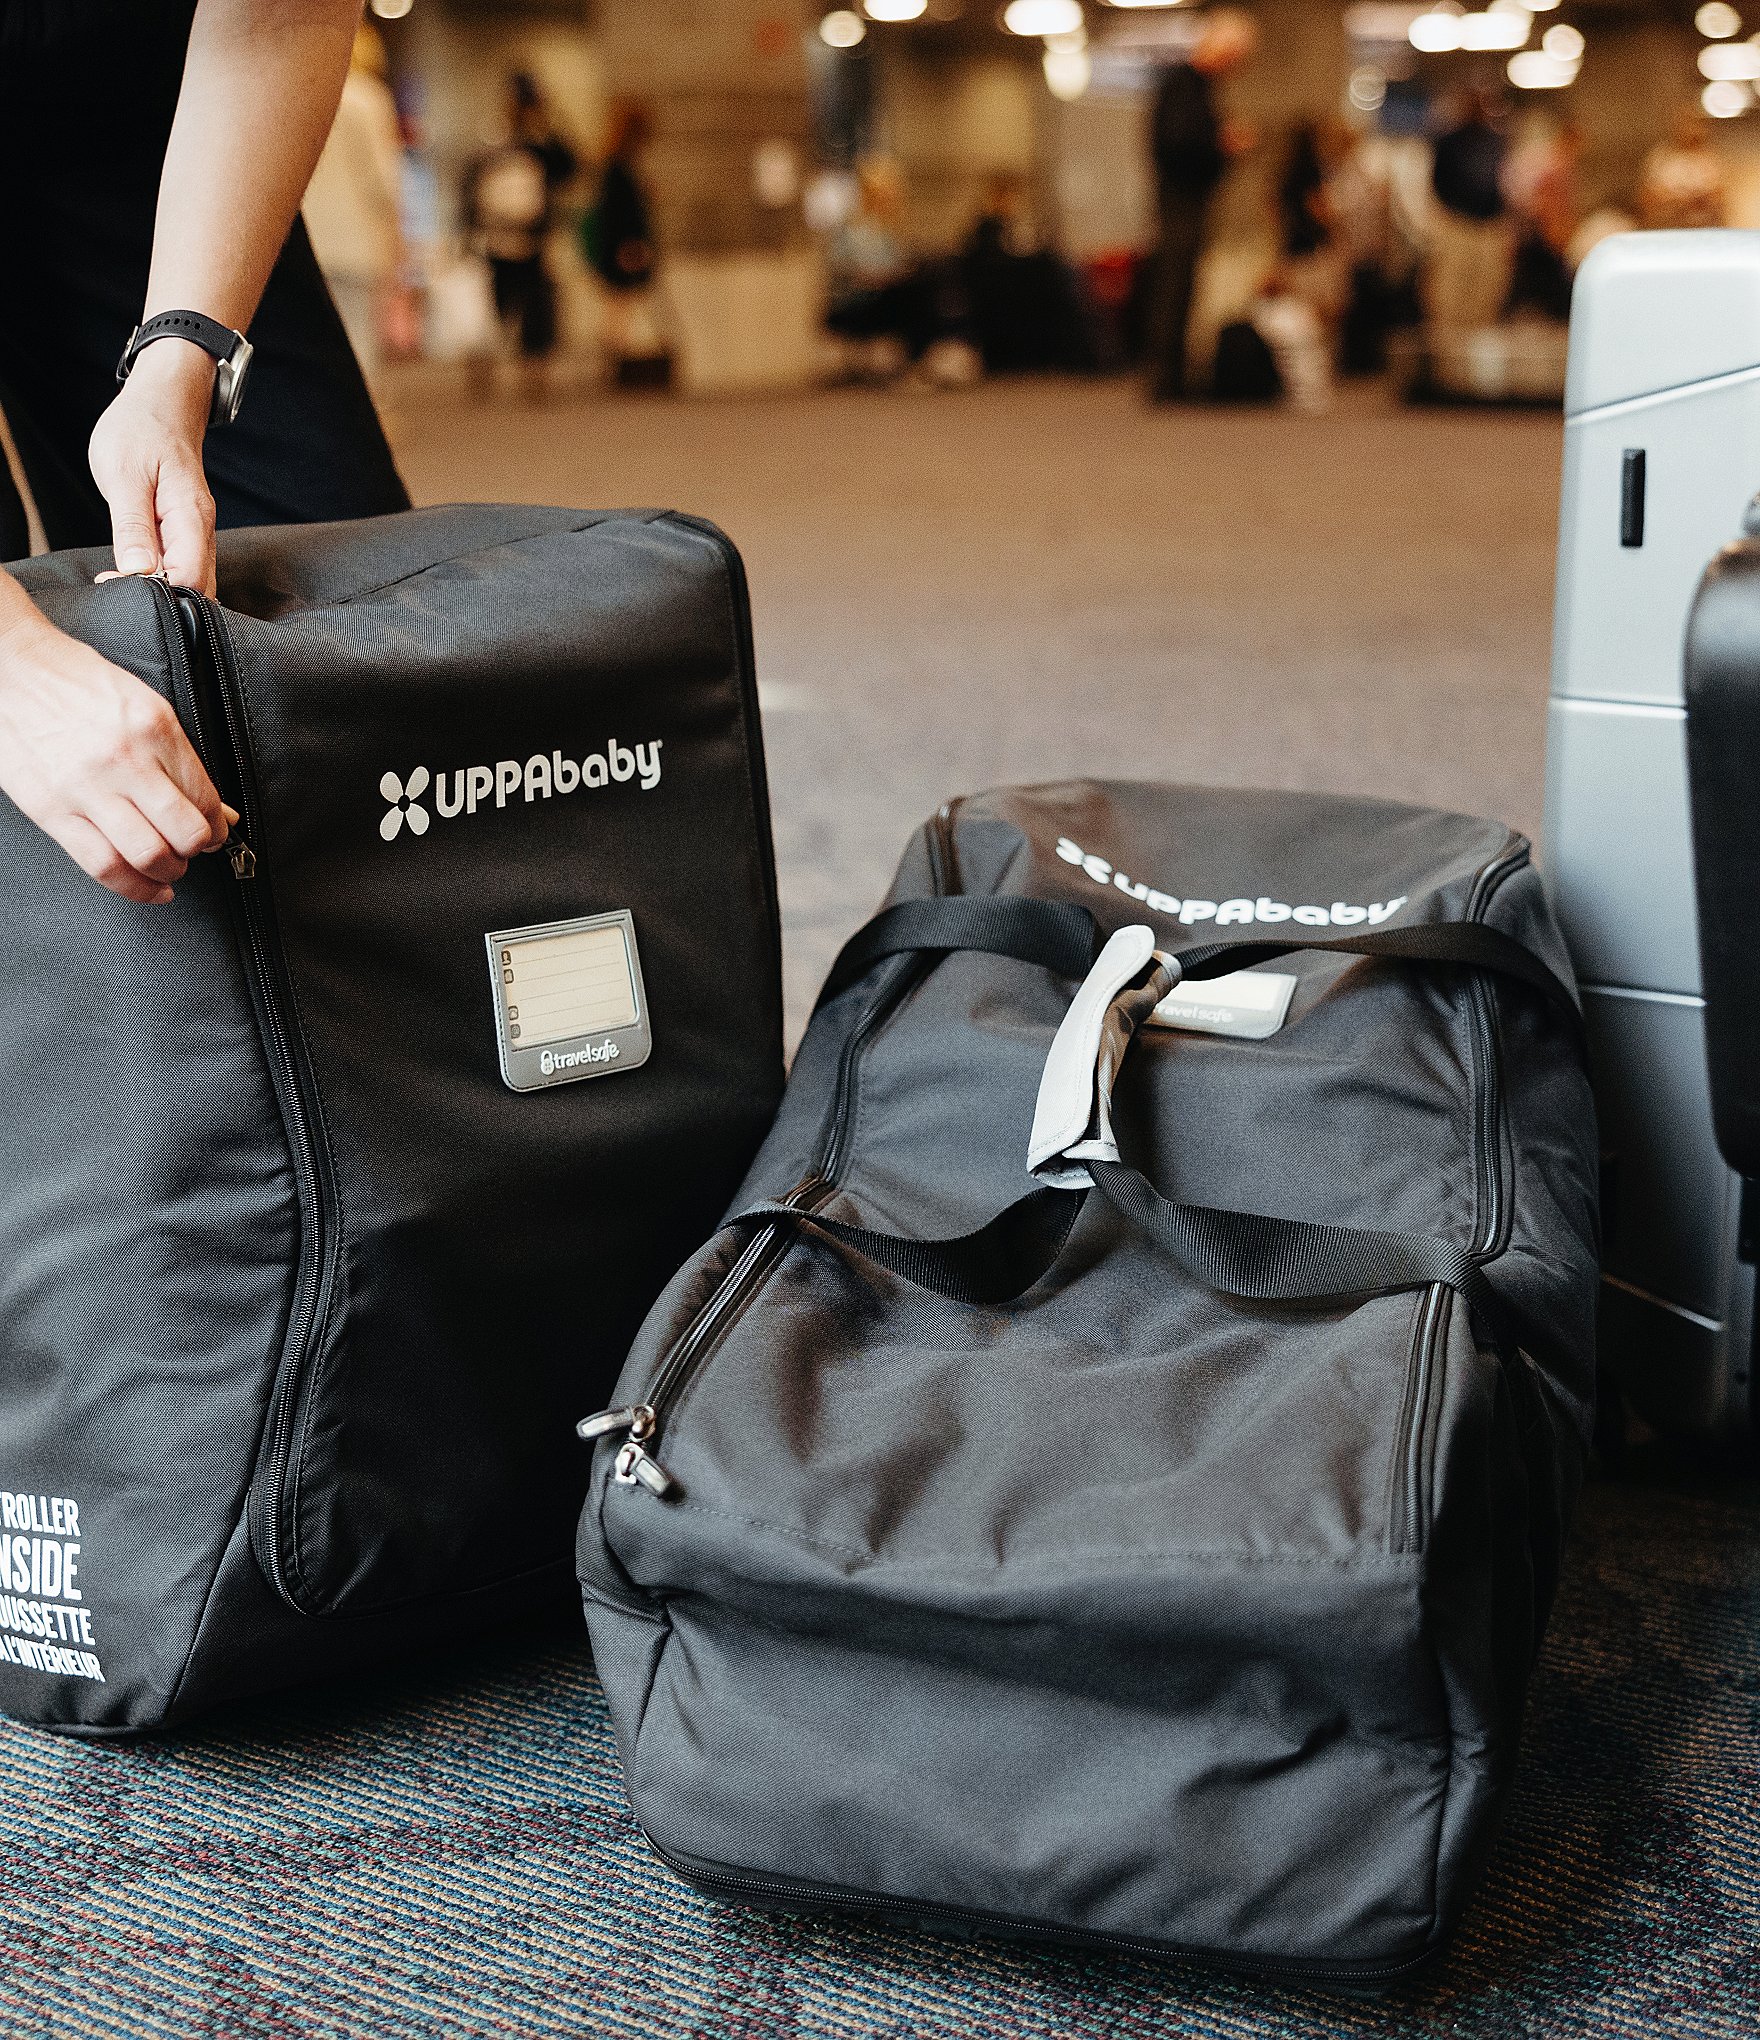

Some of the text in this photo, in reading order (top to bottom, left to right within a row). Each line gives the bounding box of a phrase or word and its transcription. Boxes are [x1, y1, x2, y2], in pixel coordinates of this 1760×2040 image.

[436, 738, 661, 818] UPPAbaby
[1155, 1004, 1234, 1023] ravelsafe
[553, 1038, 620, 1069] travelsafe
[0, 1491, 81, 1537] ROLLER
